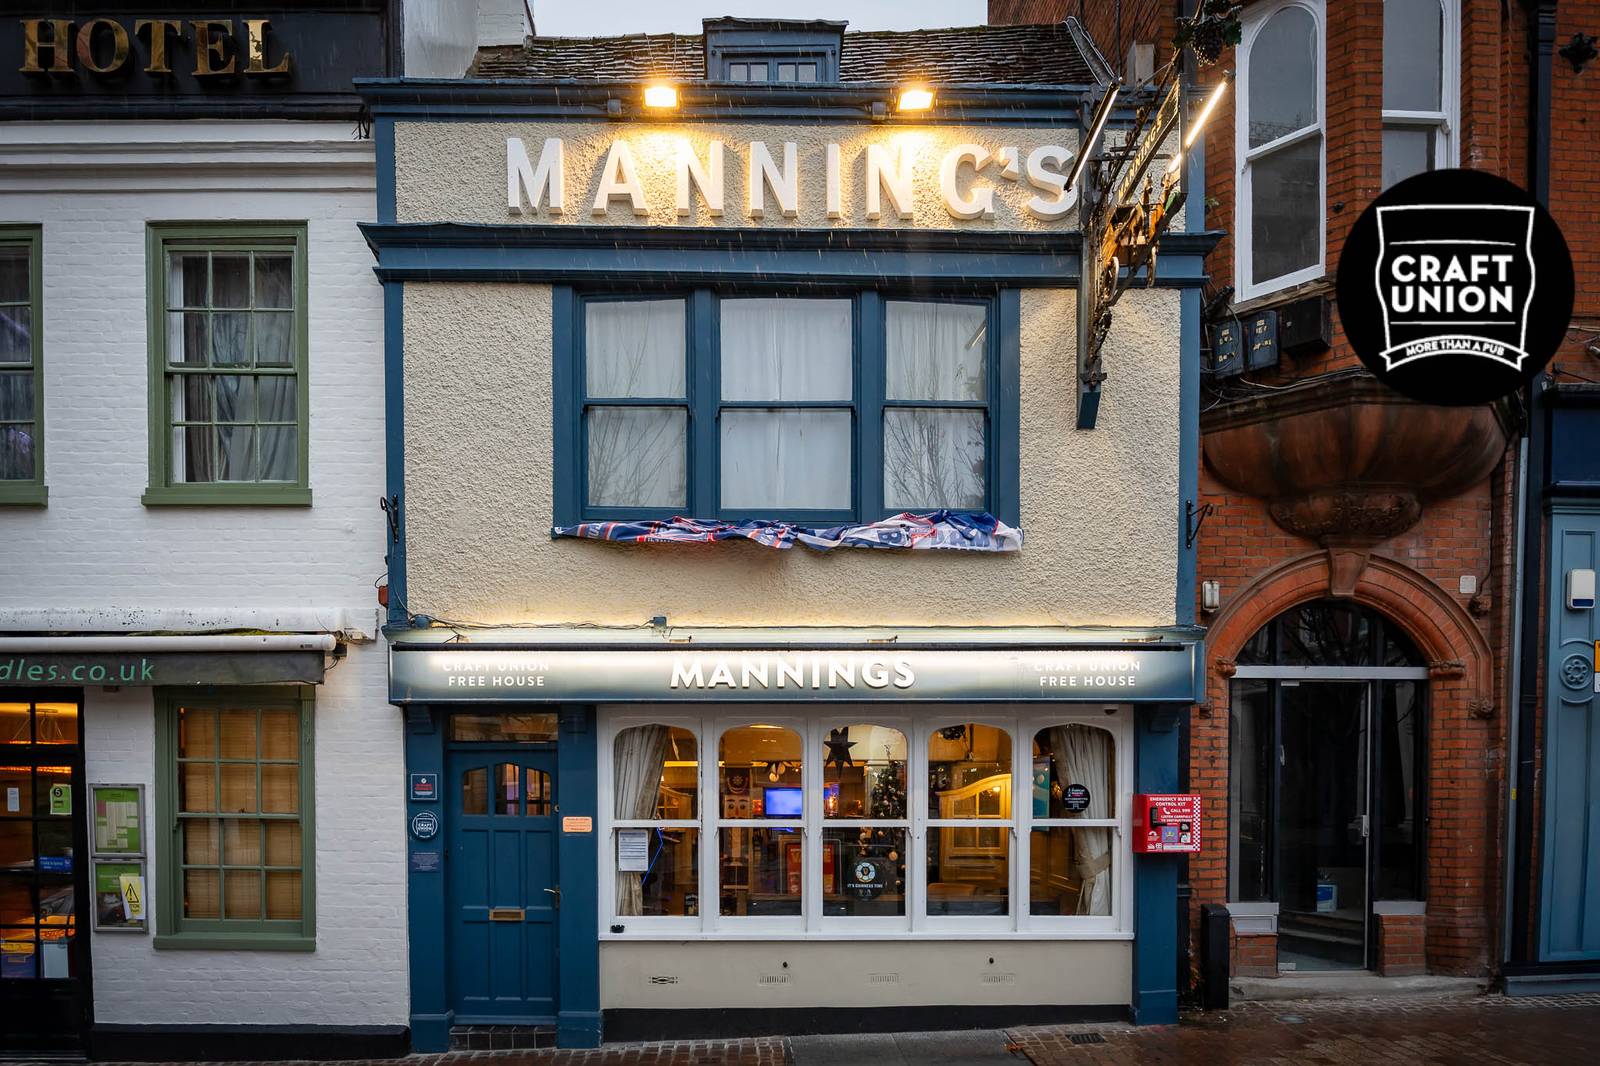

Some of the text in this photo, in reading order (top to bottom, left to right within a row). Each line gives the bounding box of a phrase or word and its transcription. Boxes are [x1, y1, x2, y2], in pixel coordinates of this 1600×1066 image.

[19, 18, 291, 76] HOTEL
[506, 137, 1078, 222] MANNING'S
[442, 661, 550, 672] CRAFT UNION
[1034, 660, 1141, 672] CRAFT UNION
[669, 657, 916, 689] MANNINGS
[448, 675, 545, 687] FREE HOUSE
[1039, 675, 1136, 687] FREE HOUSE
[55, 787, 62, 797] 5
